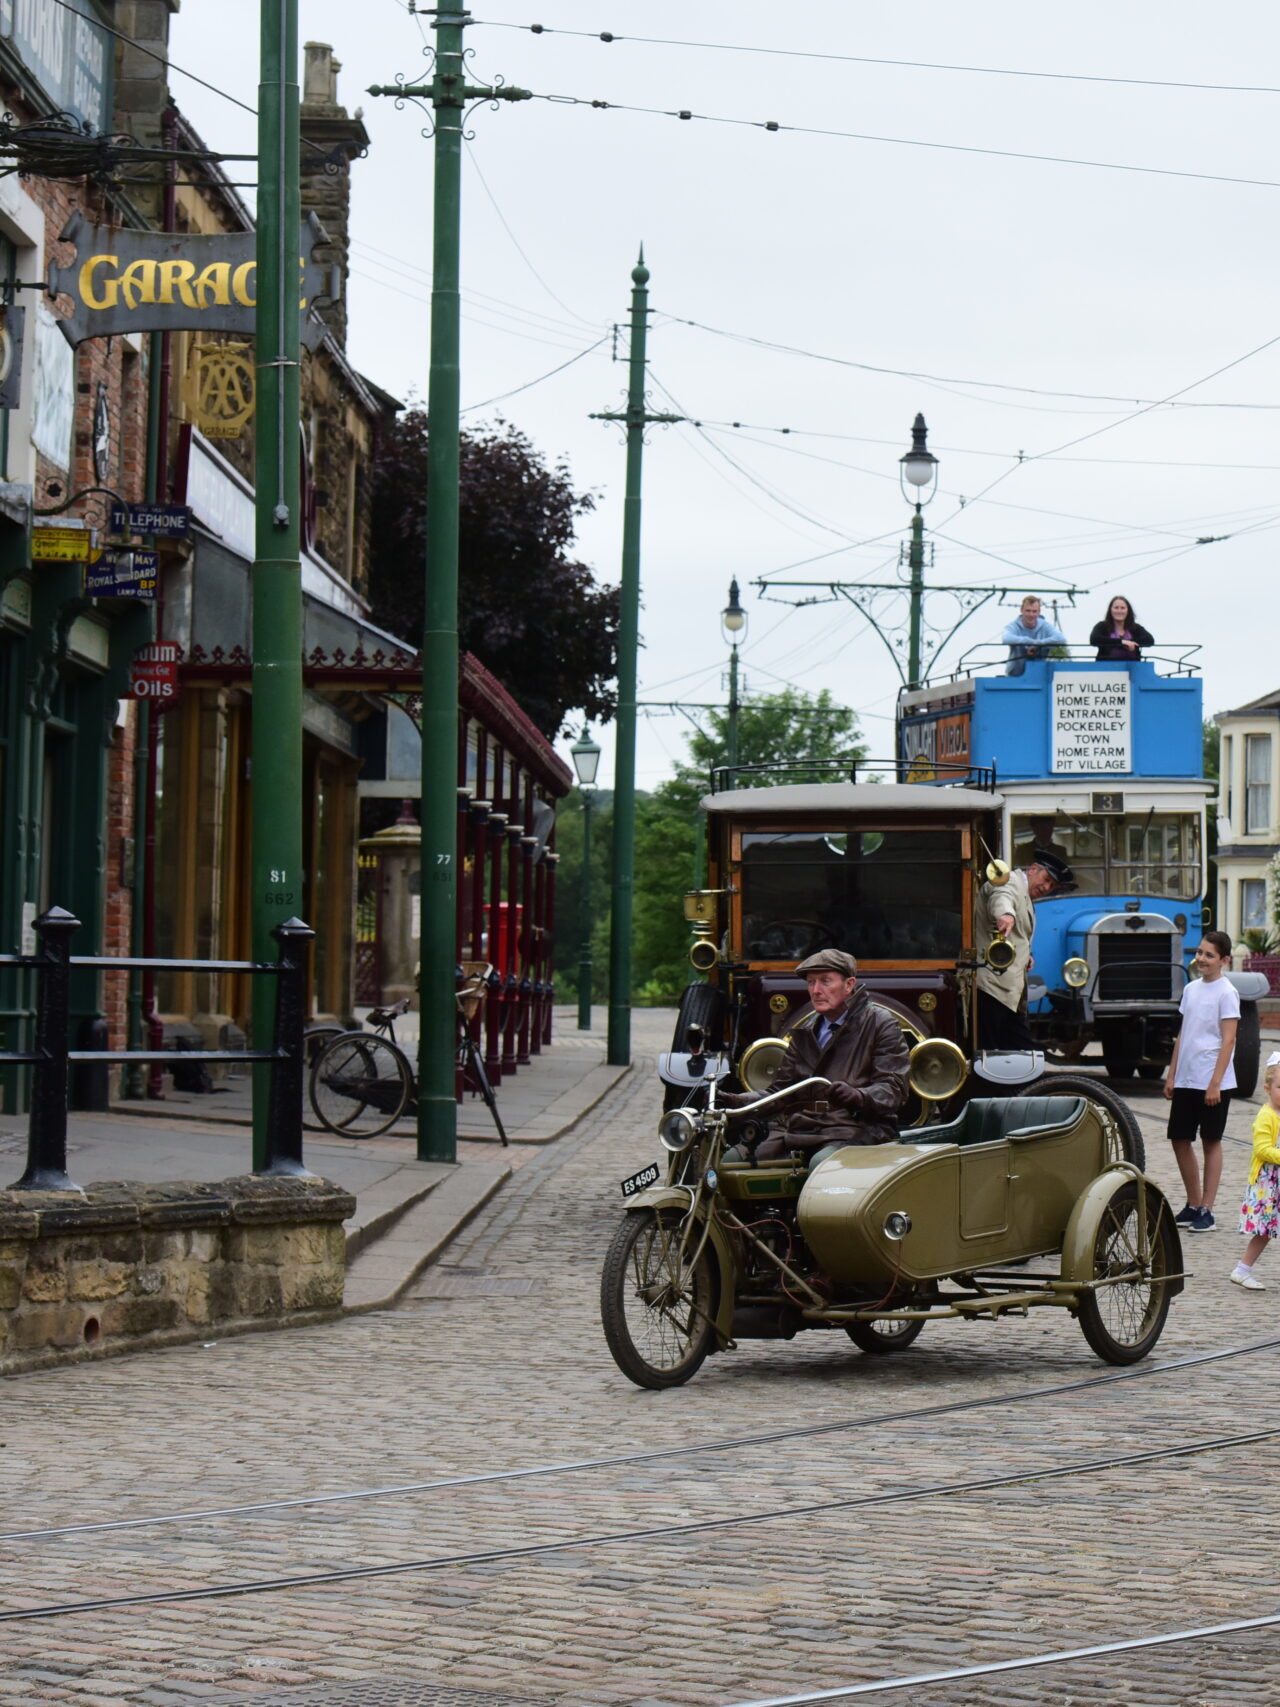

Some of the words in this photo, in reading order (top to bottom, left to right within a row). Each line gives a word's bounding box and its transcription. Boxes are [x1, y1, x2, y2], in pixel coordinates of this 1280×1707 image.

[78, 254, 307, 311] GARAG
[114, 567, 156, 585] SDARD
[140, 579, 156, 590] BP
[136, 587, 154, 598] OILS
[134, 679, 174, 697] Oils
[1056, 683, 1074, 693] PIT
[1079, 683, 1127, 693] VILLAGE
[1056, 696, 1090, 706] HOME
[1094, 696, 1126, 706] FARM
[1059, 709, 1122, 719] ENTRANCE
[1056, 722, 1126, 731] POCKERLEY
[1074, 734, 1110, 744] TOWN
[1057, 747, 1090, 757] HOME
[1093, 747, 1125, 757] FARM
[1056, 760, 1073, 770] PIT
[1078, 760, 1126, 770] VILLAGE
[1102, 795, 1113, 810] 3
[437, 854, 451, 865] 77
[623, 1180, 636, 1194] ES
[635, 1167, 657, 1187] 4509
